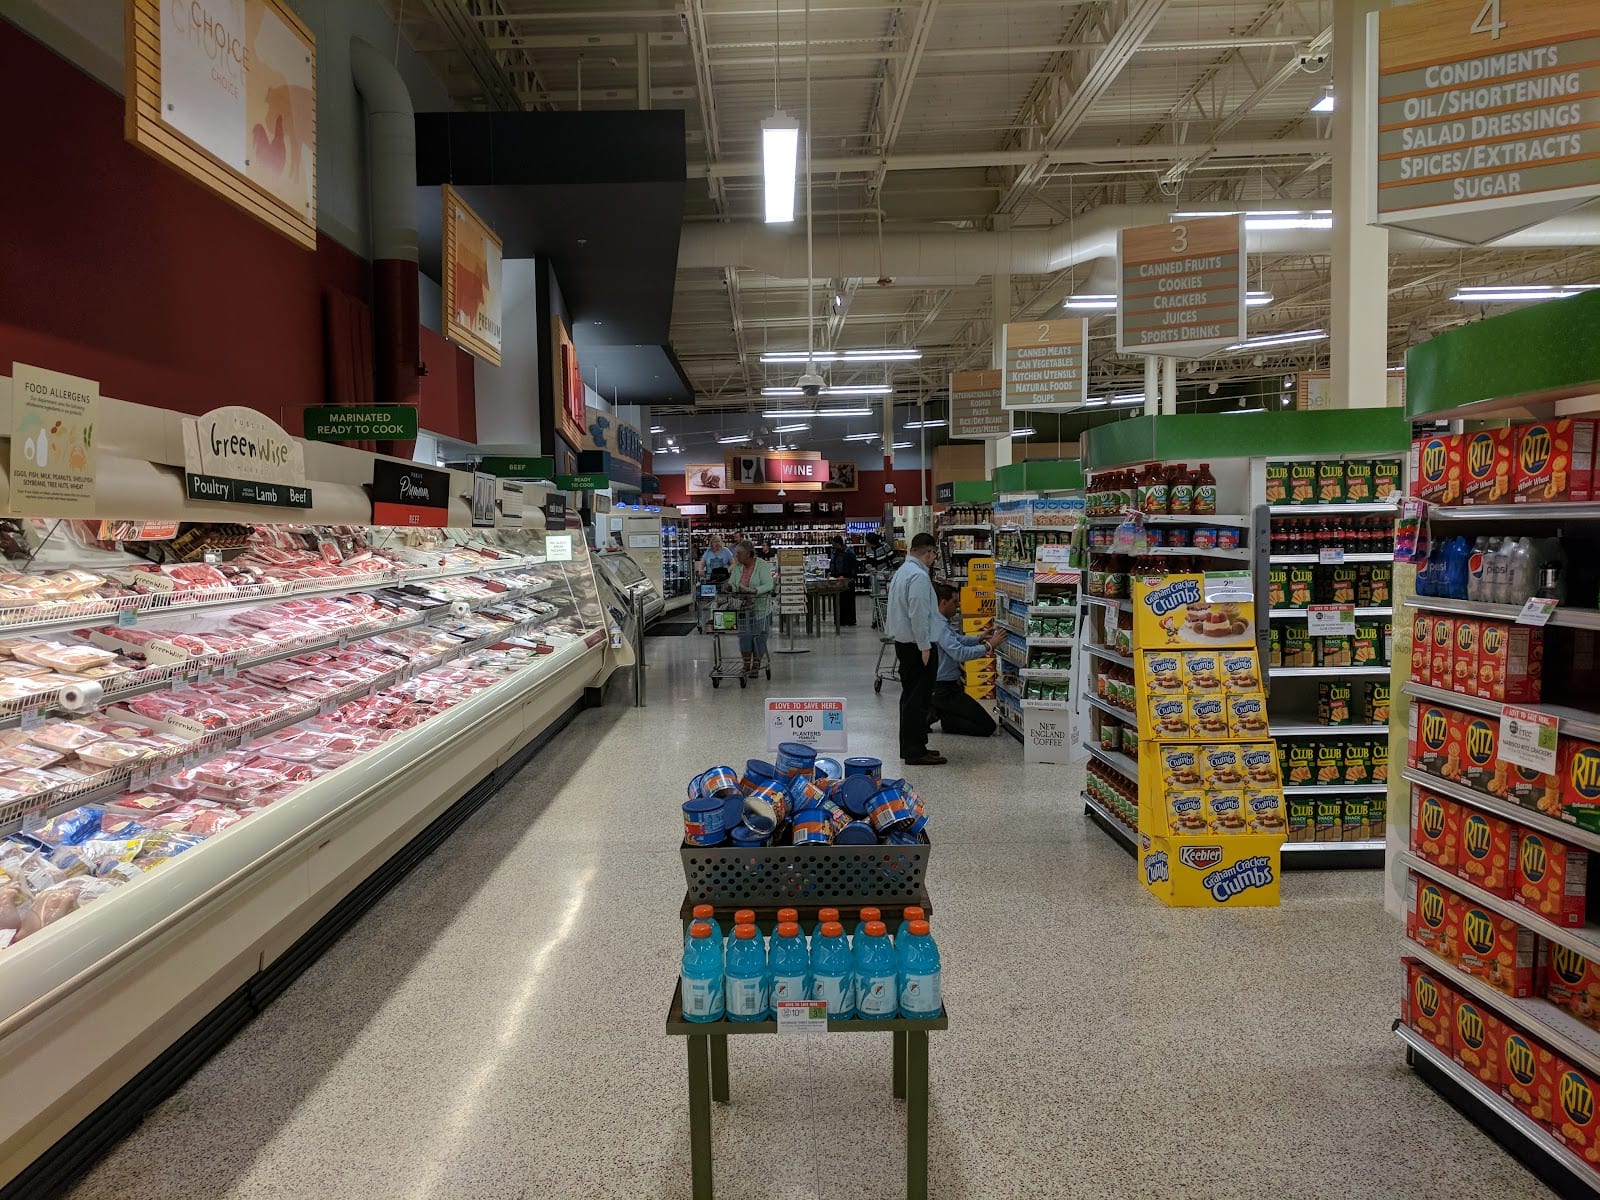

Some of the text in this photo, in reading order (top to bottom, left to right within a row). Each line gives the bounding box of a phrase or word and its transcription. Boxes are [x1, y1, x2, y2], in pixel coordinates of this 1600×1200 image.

[1470, 0, 1508, 39] 4
[191, 1, 249, 73] CHOICE
[1425, 46, 1558, 88] CONDIMENTS
[1403, 72, 1580, 121] OIL/SHORTENING
[1402, 104, 1580, 150] SALAD DRESSINGS
[1400, 133, 1581, 179] SPICES/EXTRACTS
[1453, 172, 1521, 200] SUGAR
[1170, 225, 1188, 253] 3
[1140, 256, 1221, 277] CANNED FRUITS
[1158, 276, 1202, 292] COOKIES
[1153, 293, 1207, 309] CRACKERS
[1162, 311, 1197, 325] JUICES
[1038, 323, 1050, 342] 2
[1141, 325, 1220, 343] SPORTS DRINKS
[1017, 346, 1072, 358] CANNED MEATS
[1015, 358, 1073, 370] CAN VEGETABLES
[977, 373, 984, 386] 1
[1012, 370, 1076, 382] KITCHEN UTENSILS
[25, 382, 48, 395] FOOD
[50, 388, 90, 404] ALLERGENS
[1015, 381, 1073, 393] NATURAL FOODS
[1032, 394, 1055, 403] SOUPS
[329, 413, 392, 423] MARINATED
[317, 424, 405, 435] READY TO COOK
[1468, 439, 1494, 473] RITZ
[1521, 434, 1551, 470] RITZ
[1424, 448, 1445, 476] RITZ
[782, 464, 813, 476] WINE
[1266, 467, 1288, 478] CLUB
[1292, 467, 1315, 478] CLUB
[1320, 466, 1343, 477] CLUB
[1347, 465, 1371, 477] CLUB
[1375, 464, 1399, 476] CLUB
[194, 476, 229, 499] Poultry
[256, 487, 278, 503] Lamb
[290, 489, 307, 503] Beef
[1518, 481, 1533, 492] Whole
[1291, 570, 1313, 582] CLUB
[1333, 569, 1357, 581] CLUB
[1145, 585, 1171, 604] Graham
[1170, 580, 1198, 592] Cracker
[1152, 588, 1200, 615] Crumbs
[1355, 628, 1377, 640] CLUB
[1416, 622, 1427, 637] RITZ
[1436, 625, 1447, 640] RITZ
[1459, 629, 1473, 645] RITZ
[1484, 631, 1500, 649] RITZ
[1330, 688, 1351, 700] CLUB
[1374, 687, 1390, 700] CLU
[1030, 729, 1065, 739] ENGLAND
[1039, 722, 1057, 731] NEW
[1422, 713, 1448, 741] RITZ
[1033, 737, 1063, 747] COFFEE
[1466, 723, 1494, 758] RITZ
[1291, 747, 1314, 760] CLUB
[1319, 747, 1342, 759] CLUB
[1346, 746, 1370, 759] CLUB
[1373, 746, 1389, 758] CLU
[1515, 782, 1533, 790] Bacon
[1291, 805, 1313, 817] CLUB
[1318, 804, 1341, 816] CLUB
[1345, 804, 1368, 815] CLUB
[1422, 801, 1444, 831] RITZ
[1464, 818, 1491, 851] RITZ
[1183, 849, 1221, 861] Keebler
[1521, 838, 1546, 875] RITZ
[1204, 857, 1270, 888] Graham Cracker
[1212, 867, 1273, 901] Crumbs
[1421, 887, 1445, 918] RITZ
[1463, 912, 1495, 948] RITZ
[1416, 979, 1439, 1011] RITZ
[1457, 1005, 1484, 1041] RITZ
[1506, 1038, 1535, 1077] RITZ
